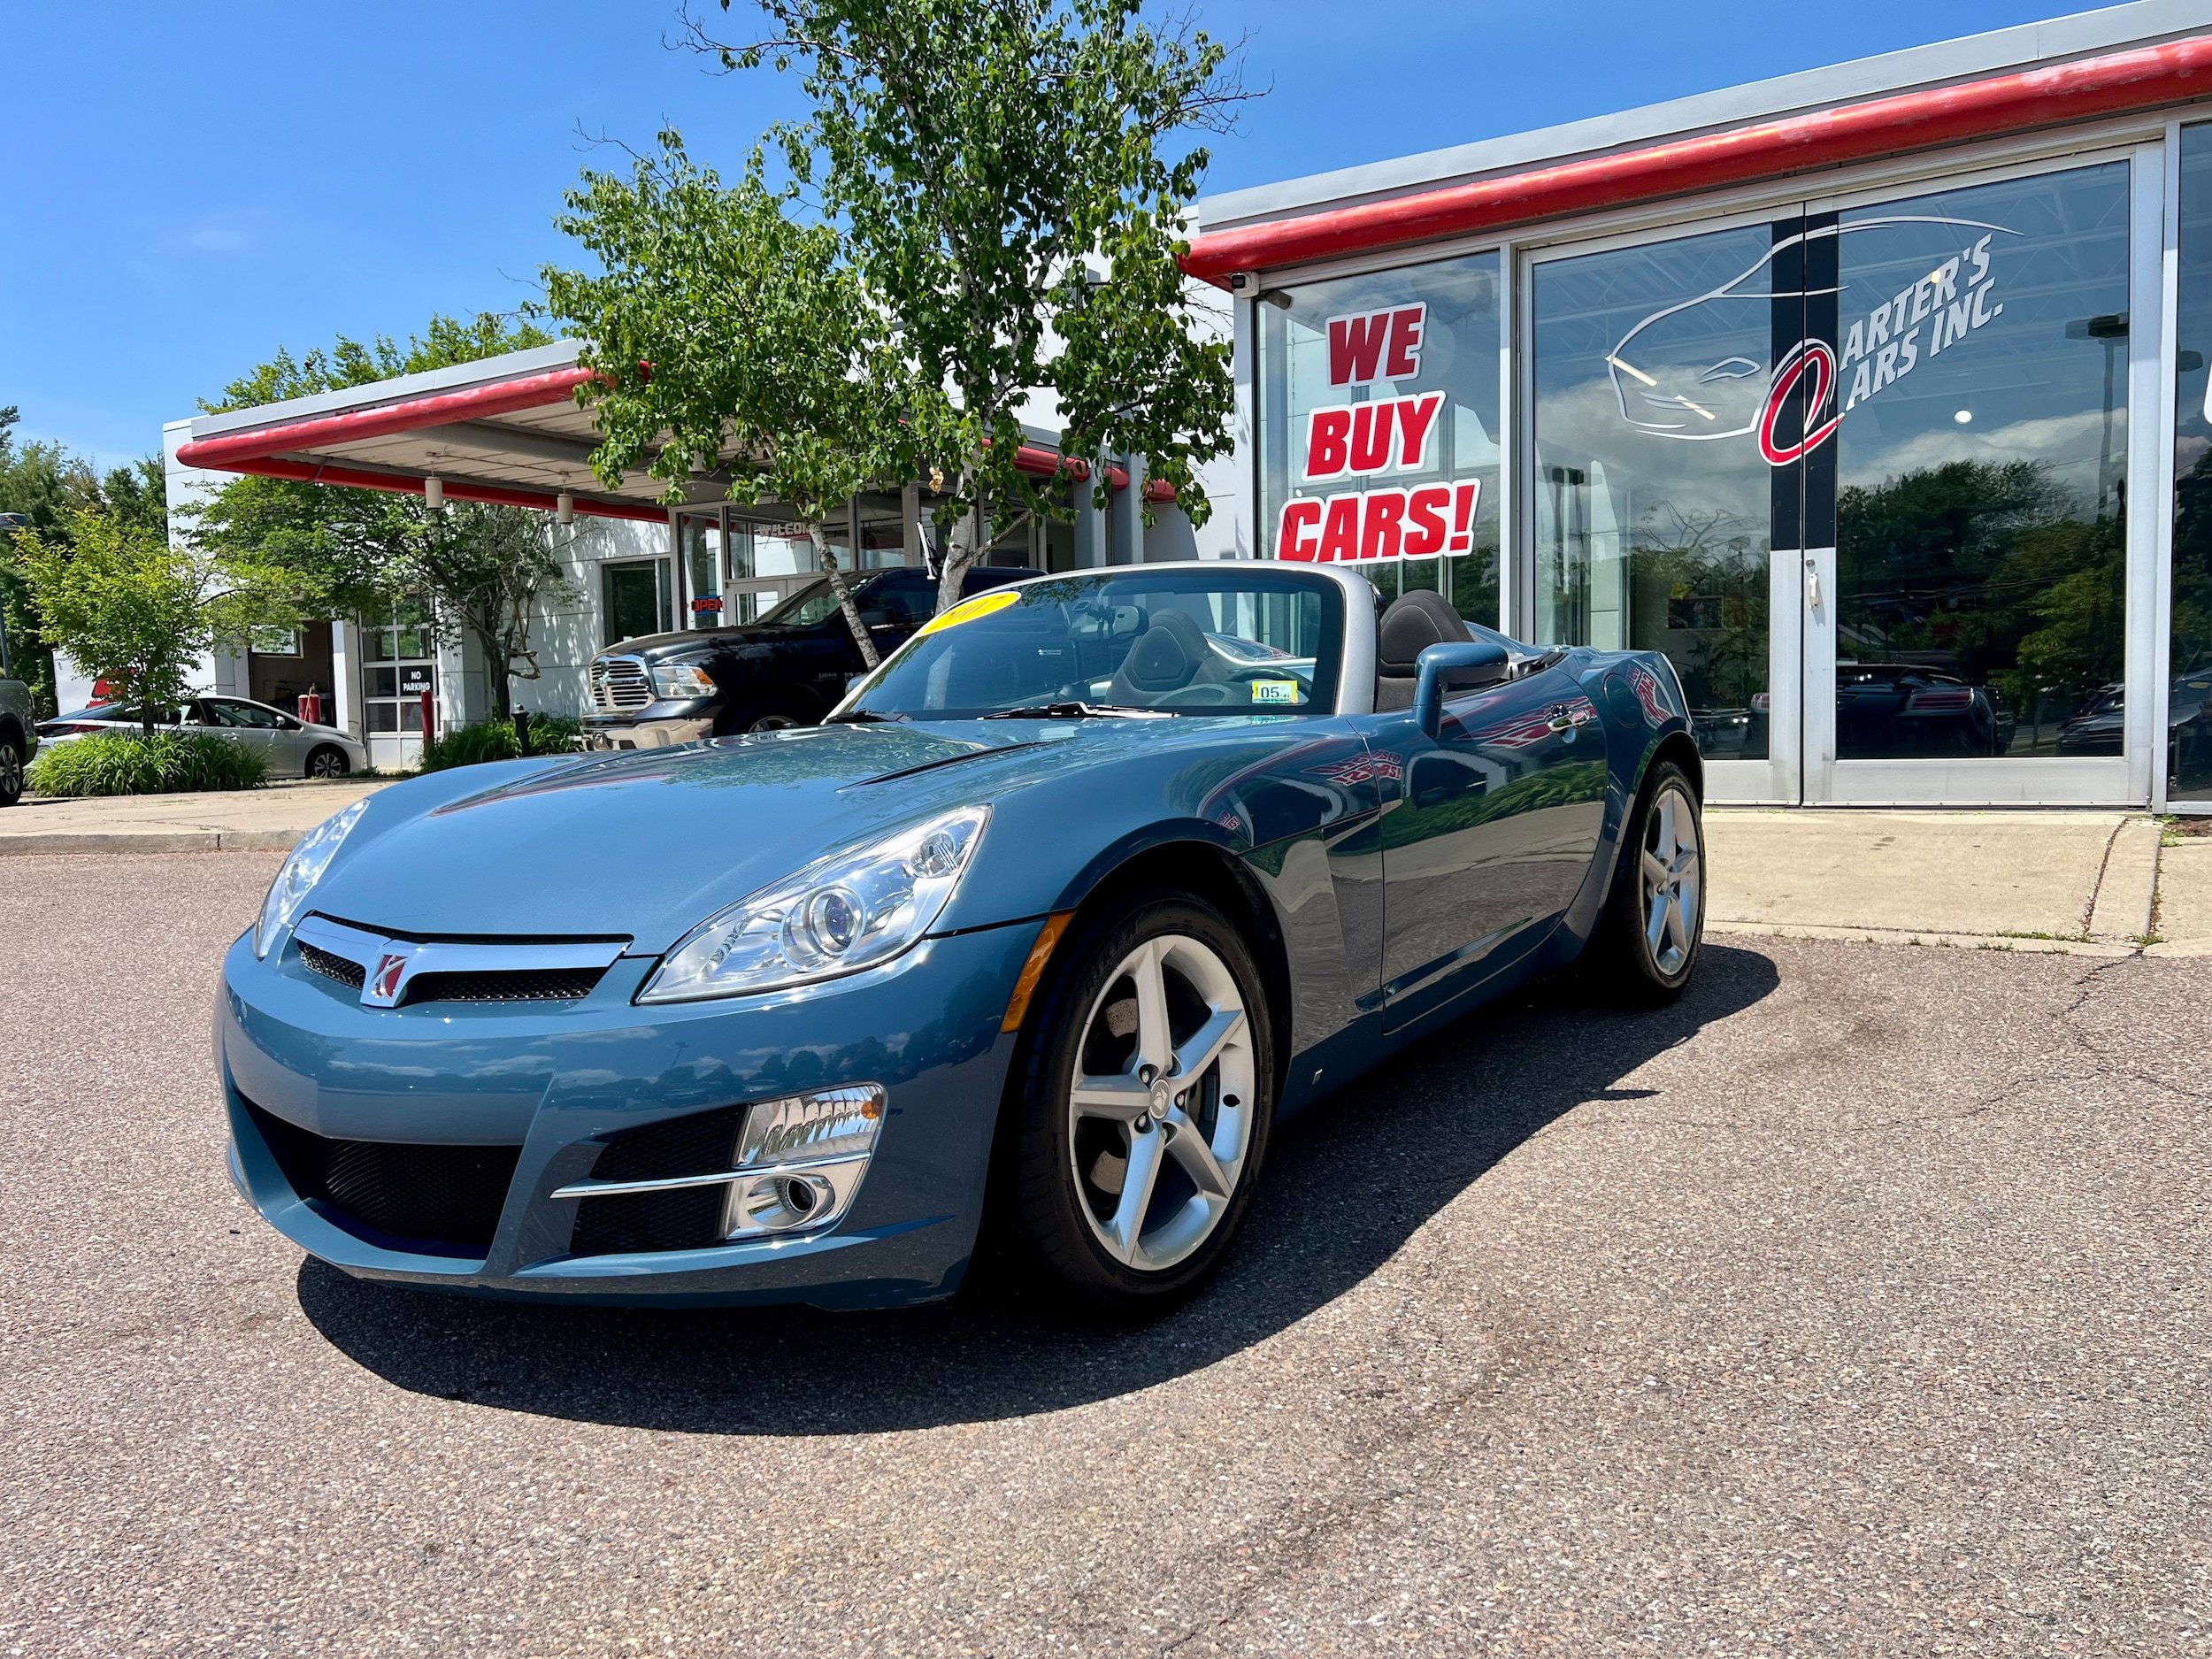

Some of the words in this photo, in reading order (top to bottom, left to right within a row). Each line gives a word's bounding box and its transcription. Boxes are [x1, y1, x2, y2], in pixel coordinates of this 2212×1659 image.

[1929, 276, 2004, 358] INC.
[1327, 305, 1425, 388] WE
[1306, 396, 1440, 478] BUY
[1278, 483, 1476, 564] CARS!
[691, 597, 724, 612] OPEN
[403, 682, 431, 692] PARKING
[411, 671, 422, 680] NO
[1260, 686, 1279, 698] 05
